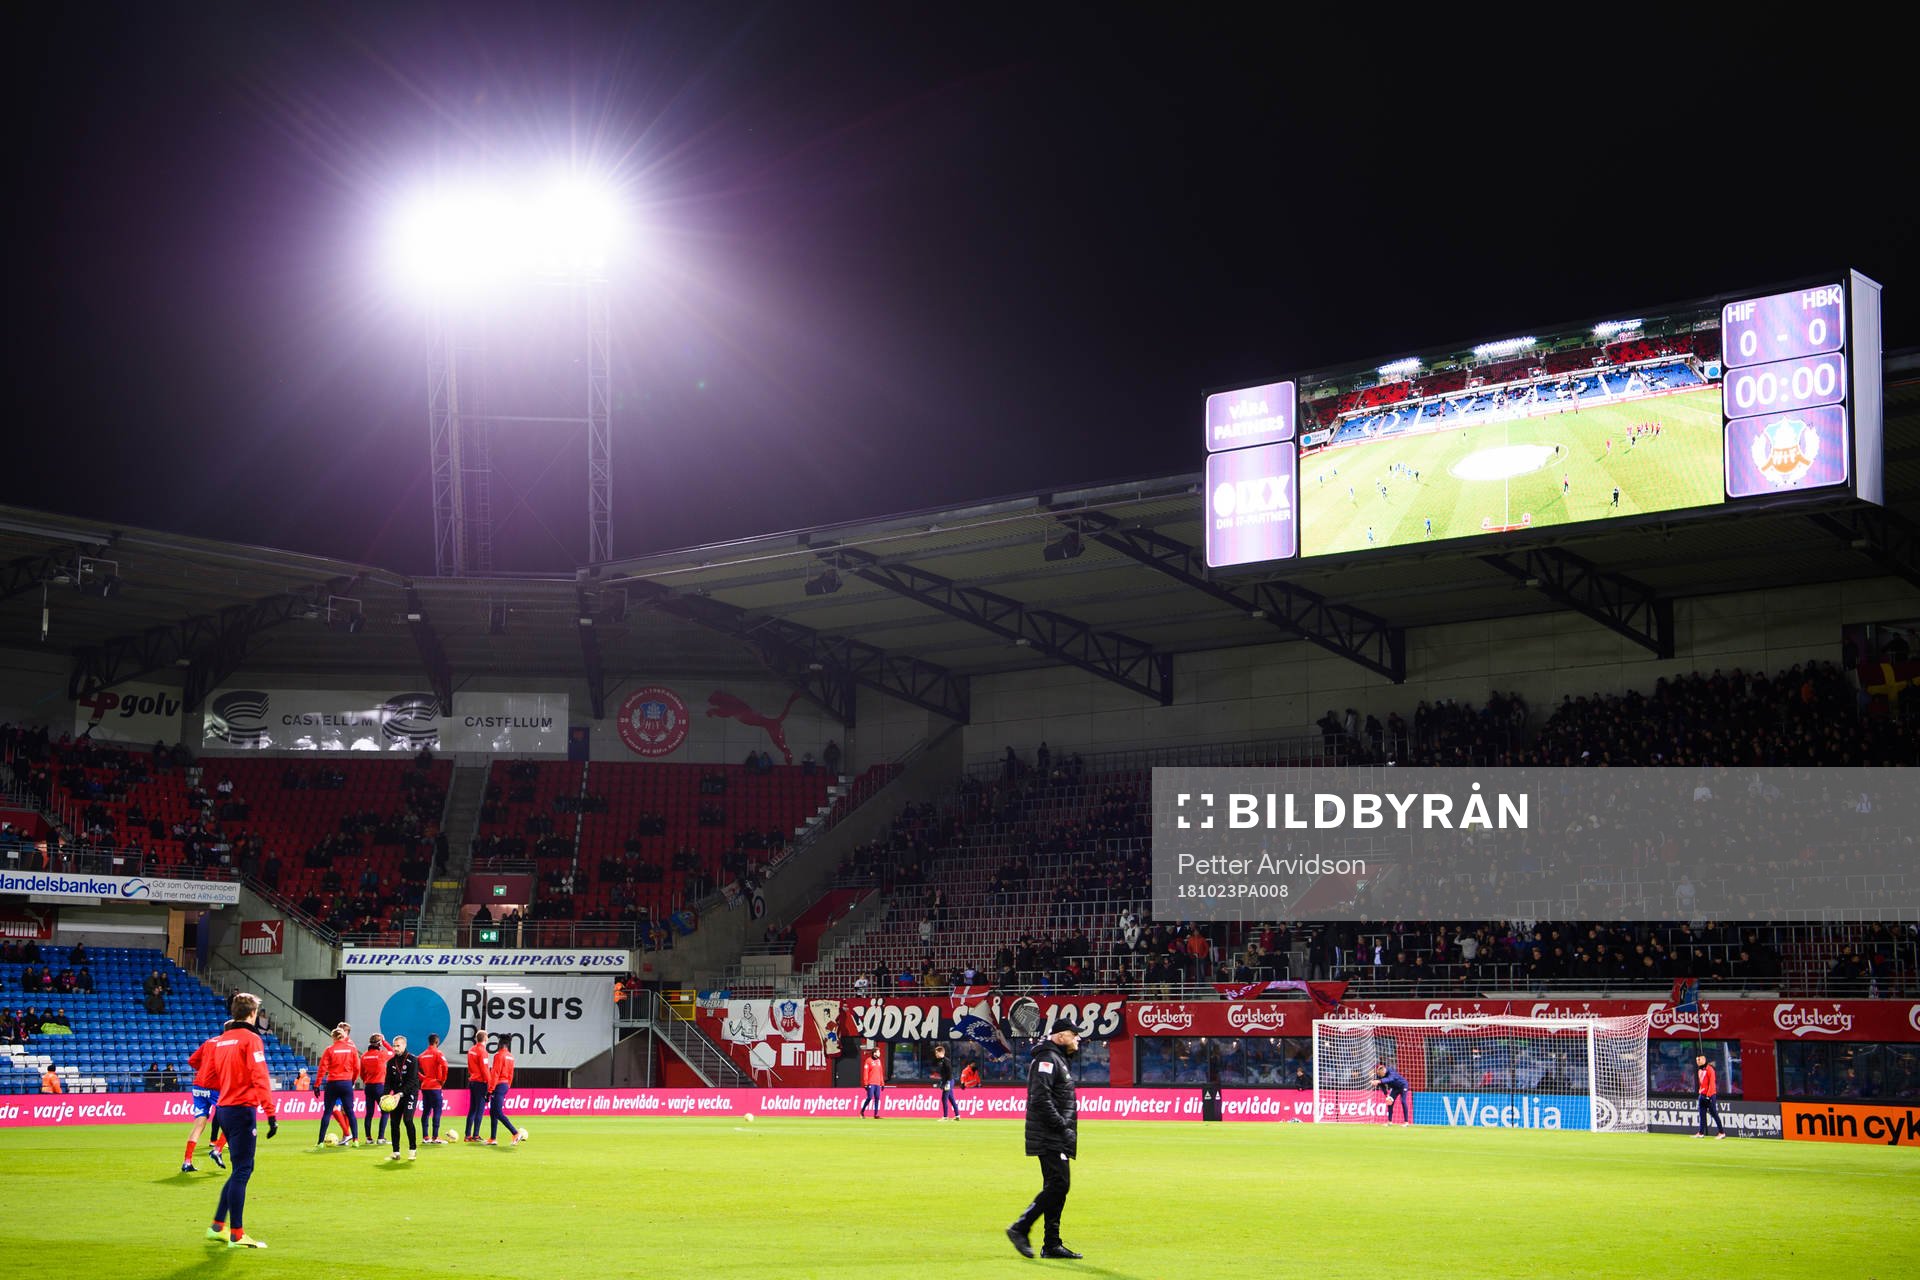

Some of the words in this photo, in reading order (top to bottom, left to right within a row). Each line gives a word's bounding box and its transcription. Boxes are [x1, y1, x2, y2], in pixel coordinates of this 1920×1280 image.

[1728, 303, 1757, 323] HIF
[1803, 287, 1840, 310] HBK
[1740, 330, 1757, 357] 0
[1809, 318, 1827, 346] 0
[1735, 363, 1836, 408] 00:00
[1229, 399, 1269, 420] VÅRA
[1214, 415, 1285, 441] PARTNERS
[120, 692, 181, 718] golv
[464, 716, 553, 728] CASTELLUM
[152, 880, 166, 888] Gör
[183, 881, 237, 893] Olympiashopen
[152, 889, 163, 899] sälj
[180, 892, 196, 900] med
[242, 937, 272, 954] PUMA
[346, 953, 434, 966] KLIPPANS
[437, 954, 485, 966] BUSS
[488, 954, 576, 966] KLIPPANS
[579, 955, 626, 967] BUSS
[460, 989, 584, 1021] Resurs
[1138, 1004, 1193, 1031] Carlsberg
[1227, 1004, 1284, 1031] Carlsberg
[1773, 1003, 1853, 1033] Carlsberg
[458, 1024, 547, 1055] Bank
[33, 1102, 75, 1122] varje
[78, 1101, 127, 1118] vecka.
[284, 1097, 306, 1113] din
[534, 1095, 586, 1113] nyheter
[594, 1095, 610, 1110] din
[612, 1094, 659, 1110] brevlåda
[668, 1097, 695, 1113] varje
[697, 1096, 733, 1110] vecka.
[761, 1095, 801, 1110] Lokala
[803, 1096, 851, 1114] nyheter
[884, 1094, 940, 1111] brevlåda
[1076, 1095, 1111, 1112] okala
[1114, 1096, 1174, 1117] nyheter
[1221, 1096, 1281, 1116] revlåda
[1443, 1096, 1562, 1129] Weelia
[1720, 1102, 1732, 1112] VI
[1796, 1107, 1858, 1138] min
